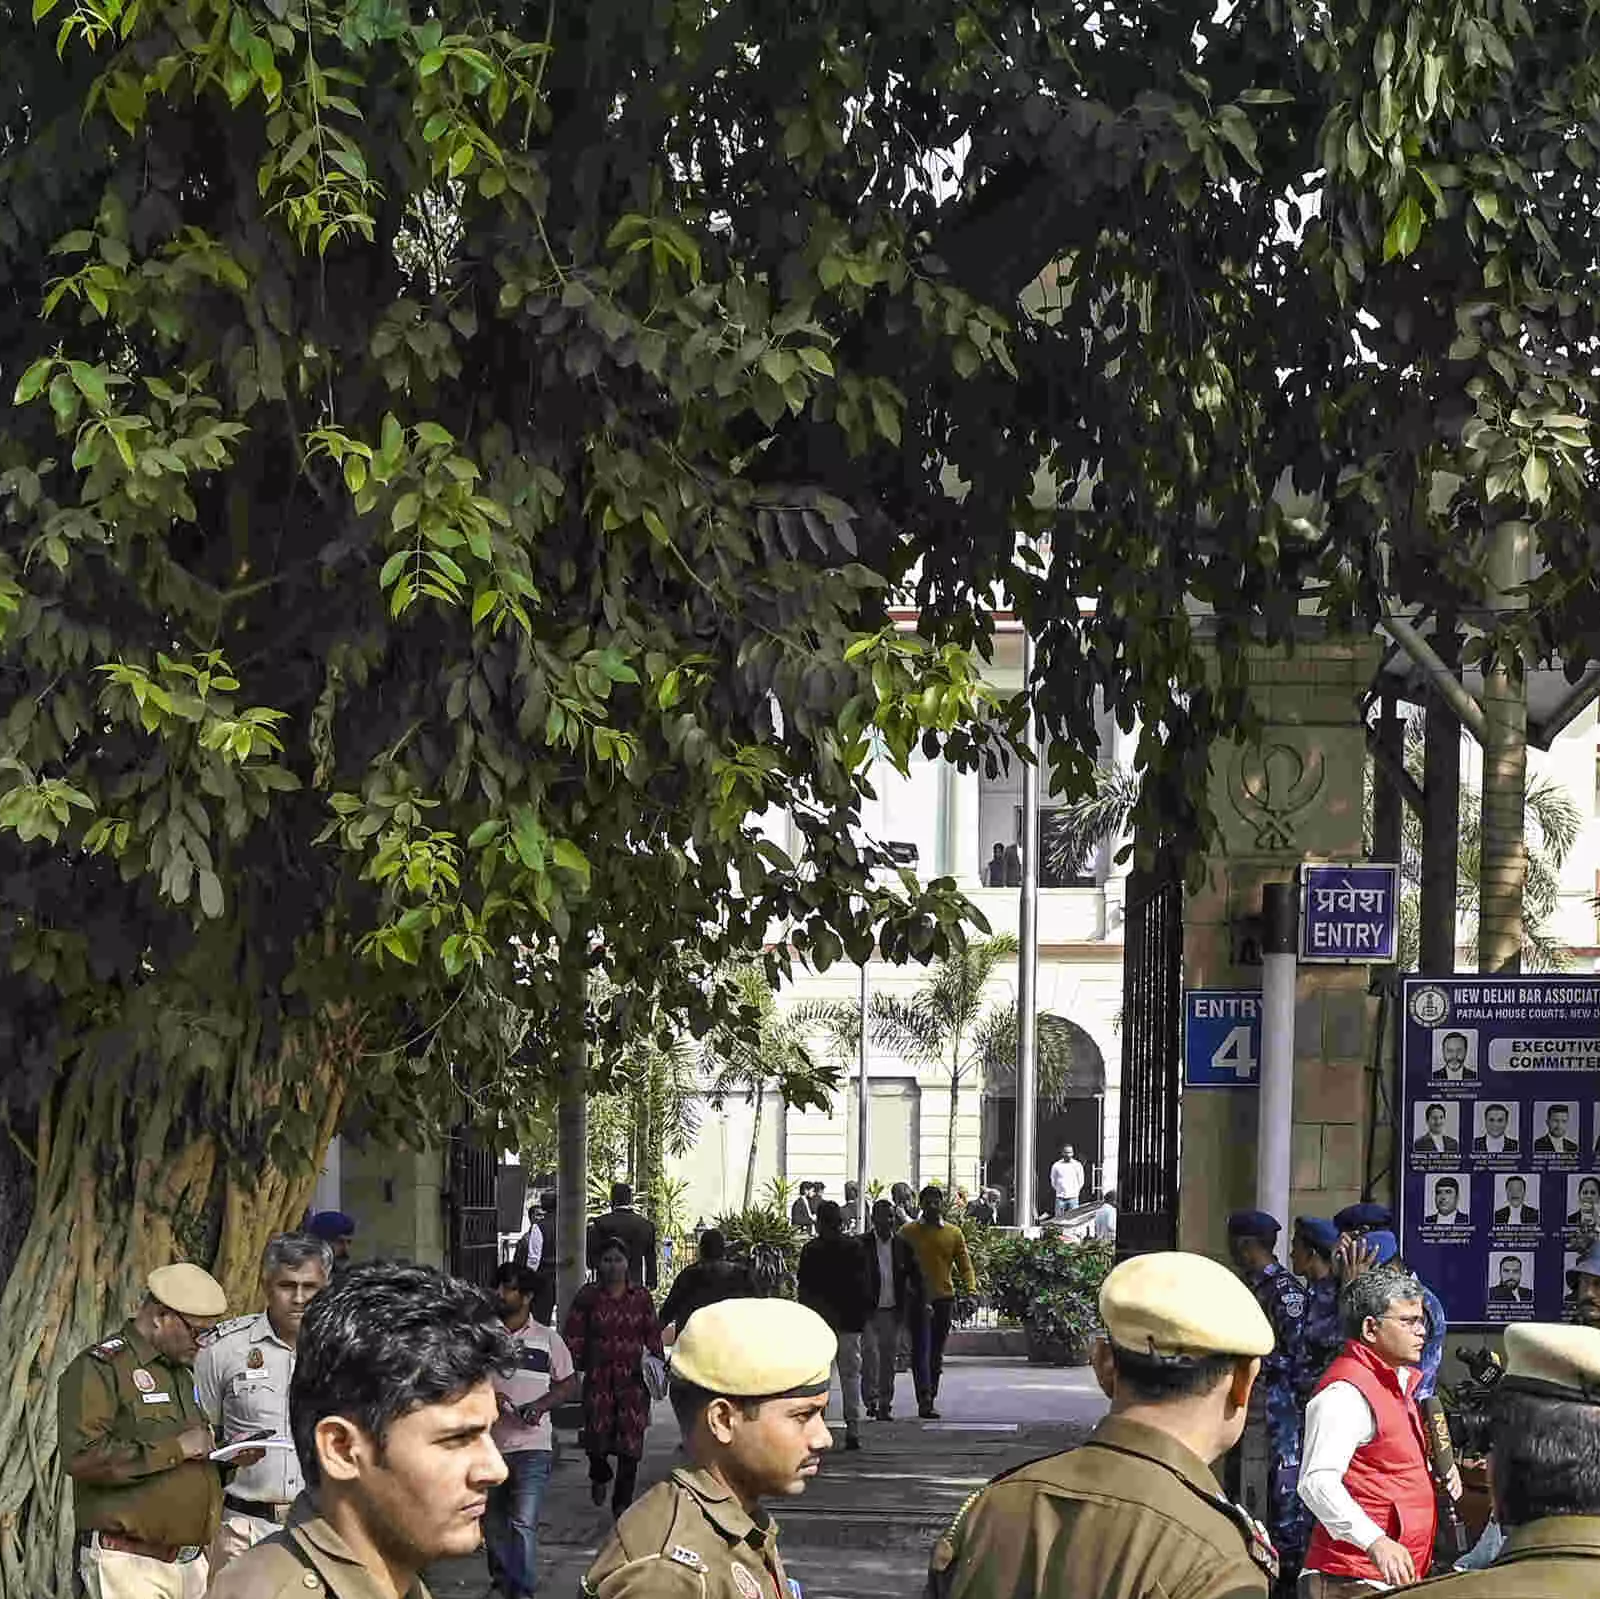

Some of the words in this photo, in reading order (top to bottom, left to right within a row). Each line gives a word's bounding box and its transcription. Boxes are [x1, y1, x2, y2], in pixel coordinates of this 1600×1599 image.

[1314, 880, 1386, 914] प्रवेश
[1313, 923, 1385, 949] ENTRY
[1454, 987, 1479, 1004] NEW
[1483, 987, 1515, 1004] DELHI
[1518, 987, 1541, 1004] BAR
[1456, 1008, 1493, 1019] PATIALA
[1496, 1008, 1526, 1019] HOUSE
[1570, 1008, 1591, 1019] NEW
[1210, 1026, 1258, 1078] 4
